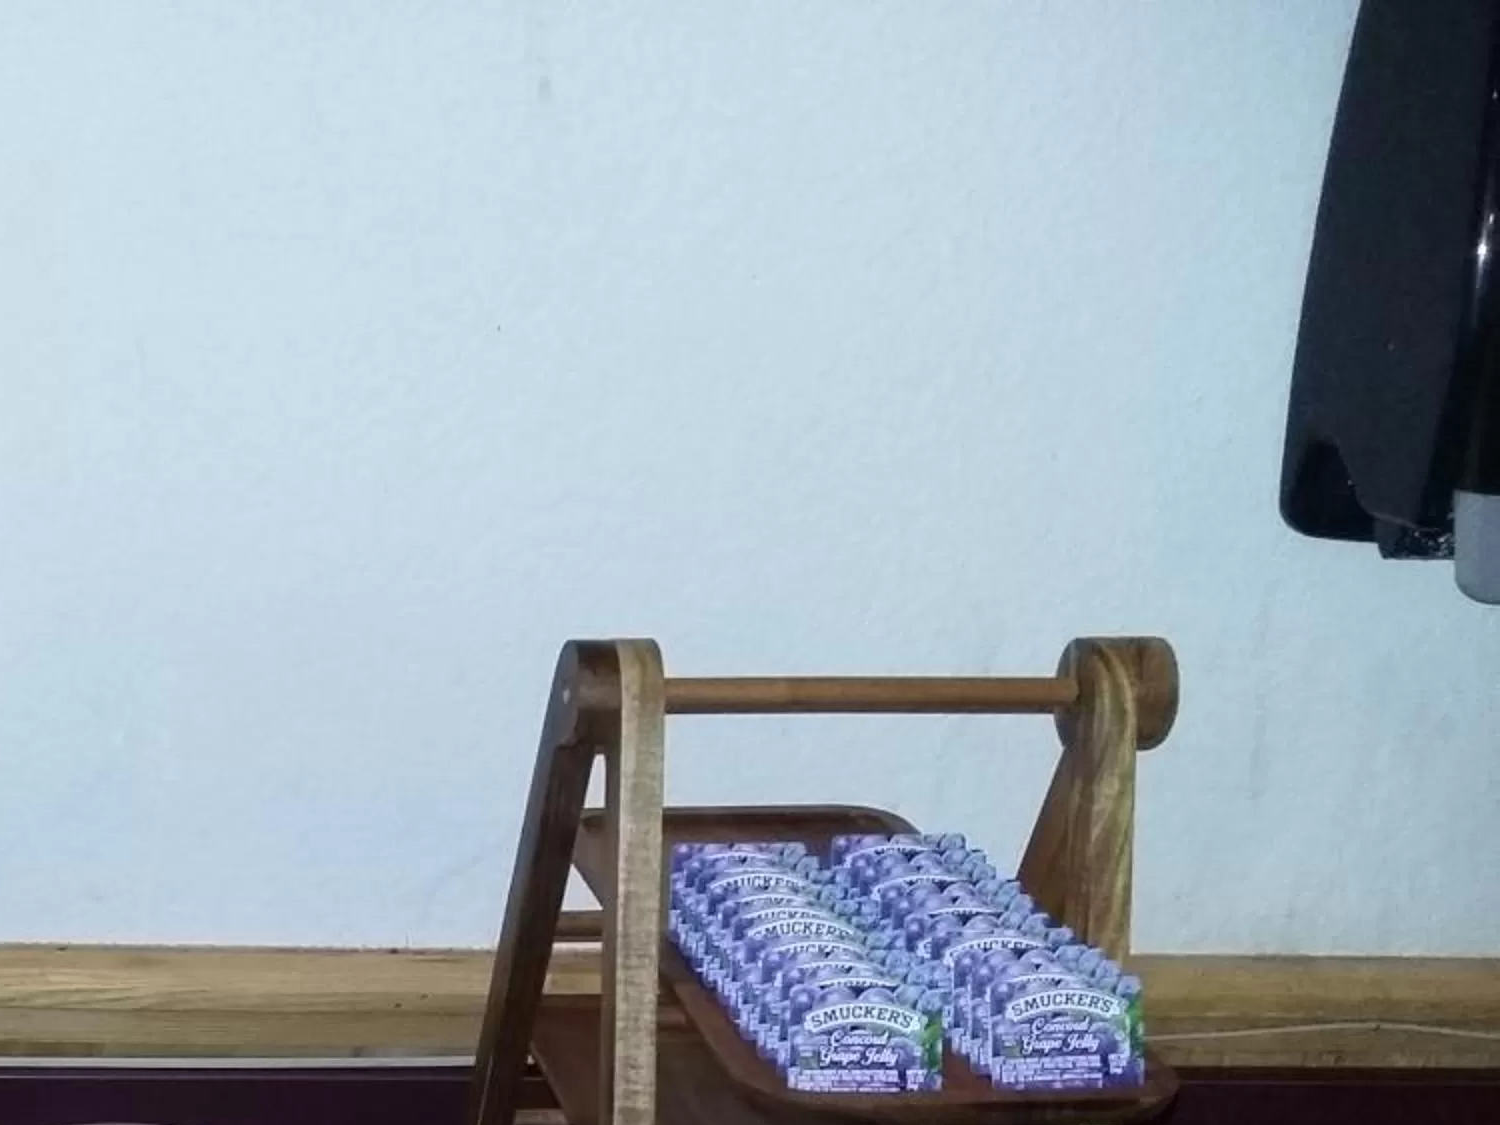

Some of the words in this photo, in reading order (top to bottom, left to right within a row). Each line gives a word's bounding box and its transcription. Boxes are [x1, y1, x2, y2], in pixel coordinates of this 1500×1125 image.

[1031, 1016, 1090, 1034] Concord
[830, 1030, 889, 1047] Concord
[1021, 1033, 1063, 1054] Grape
[1062, 1033, 1100, 1053] Jelly
[820, 1046, 860, 1067] Grape
[862, 1046, 899, 1068] Jelly
